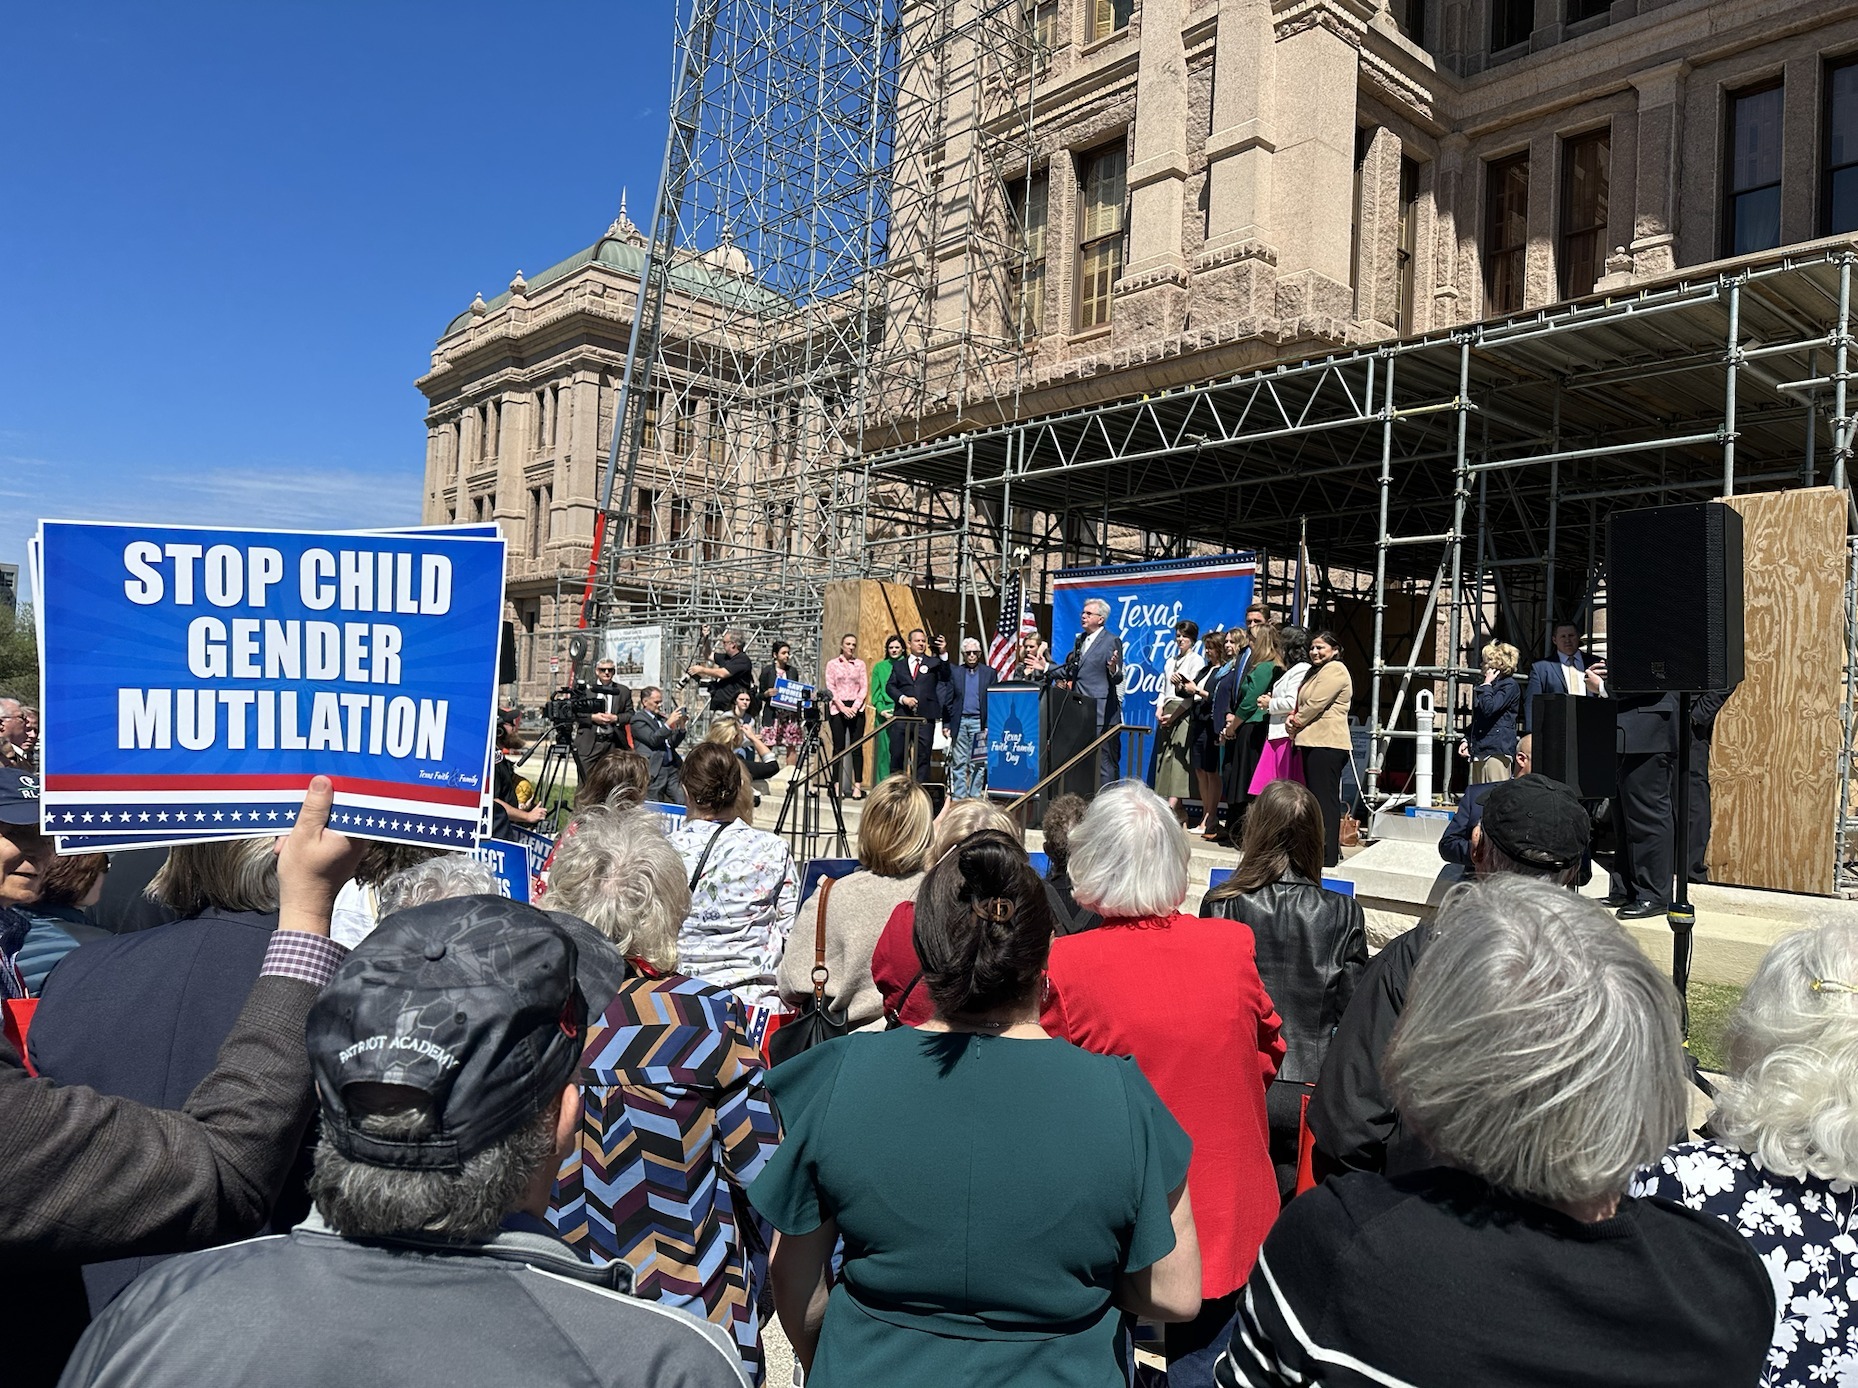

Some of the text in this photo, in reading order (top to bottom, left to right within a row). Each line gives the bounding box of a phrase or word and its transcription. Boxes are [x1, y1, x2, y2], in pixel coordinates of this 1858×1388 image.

[123, 541, 452, 615] STOP CHILD
[1117, 595, 1183, 630] Texas
[187, 616, 403, 684] GENDER
[118, 688, 449, 761] MUTILATION
[1002, 730, 1022, 742] Texas
[991, 740, 1008, 752] Faith
[1012, 741, 1036, 757] Family
[1005, 751, 1020, 766] Day
[419, 769, 434, 780] Texas
[433, 771, 450, 781] Faith
[458, 773, 479, 787] Family
[339, 1035, 460, 1070] PATRIOT ACADEMY
